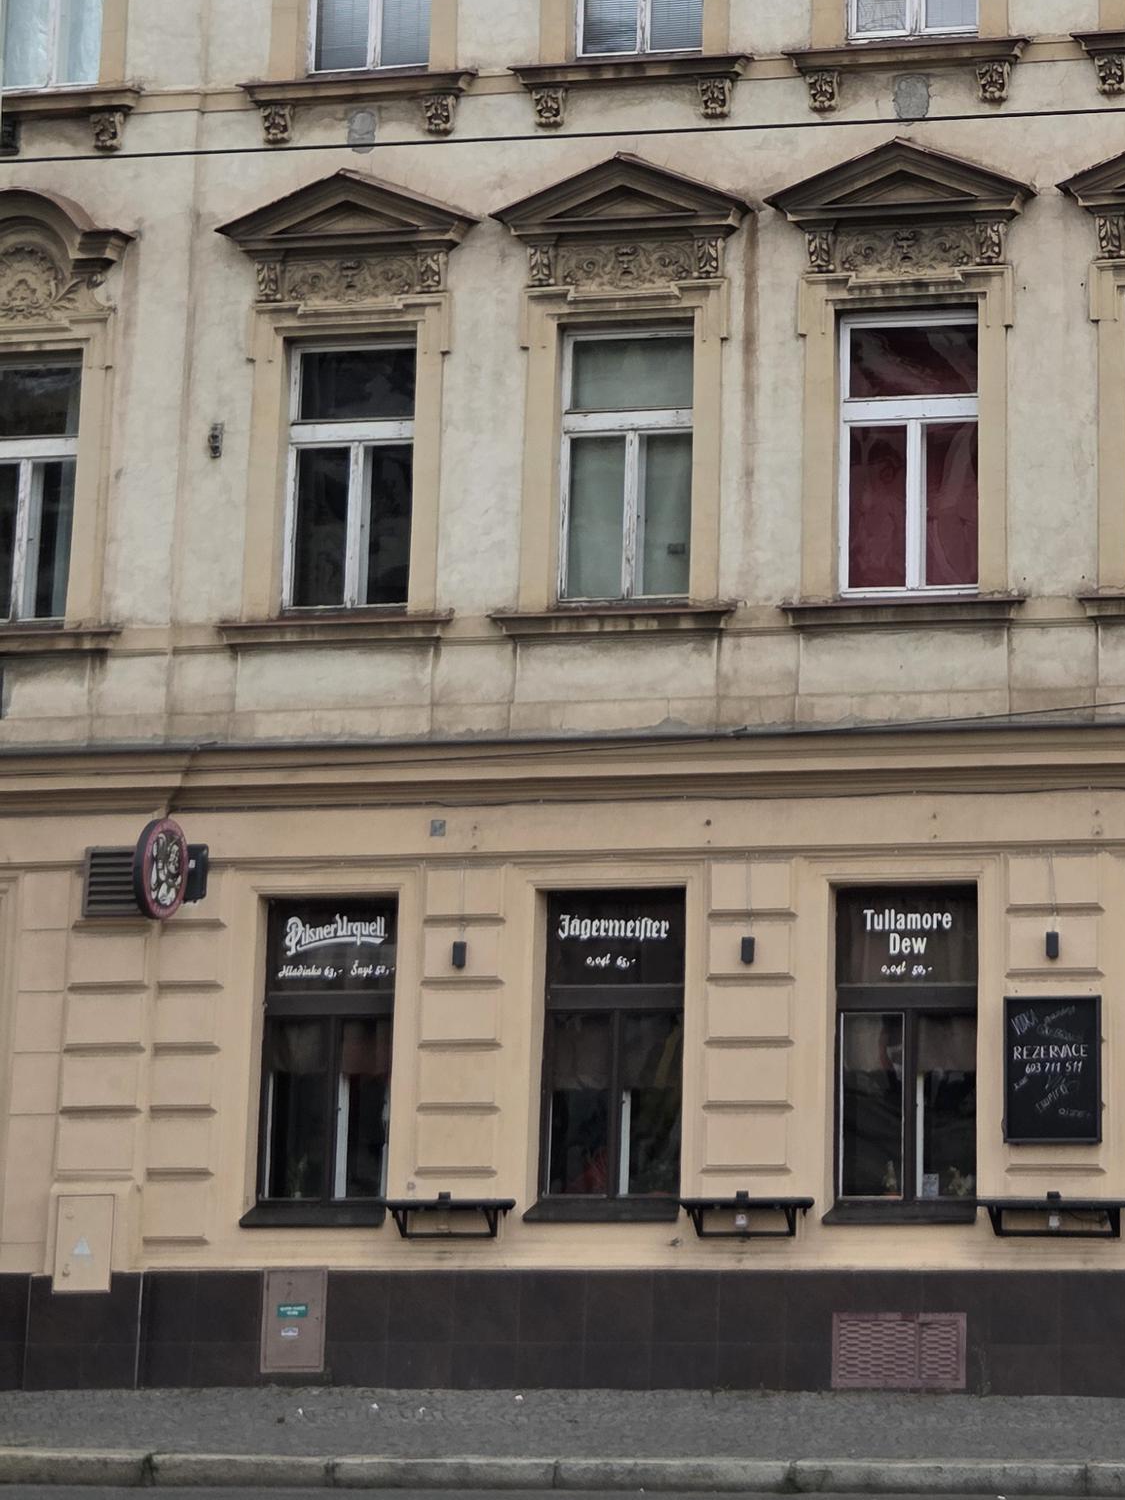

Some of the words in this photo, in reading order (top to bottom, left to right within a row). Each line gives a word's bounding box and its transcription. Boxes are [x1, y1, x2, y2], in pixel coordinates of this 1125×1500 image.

[863, 908, 952, 931] Tullamore
[285, 916, 338, 957] Pilsner
[335, 913, 387, 946] Urquell
[889, 932, 927, 955] Dew
[278, 964, 322, 978] Hladinka
[1013, 1043, 1089, 1061] REZERVACE
[1025, 1062, 1041, 1074] 603
[1044, 1062, 1061, 1073] 711
[1065, 1060, 1083, 1073] 511
